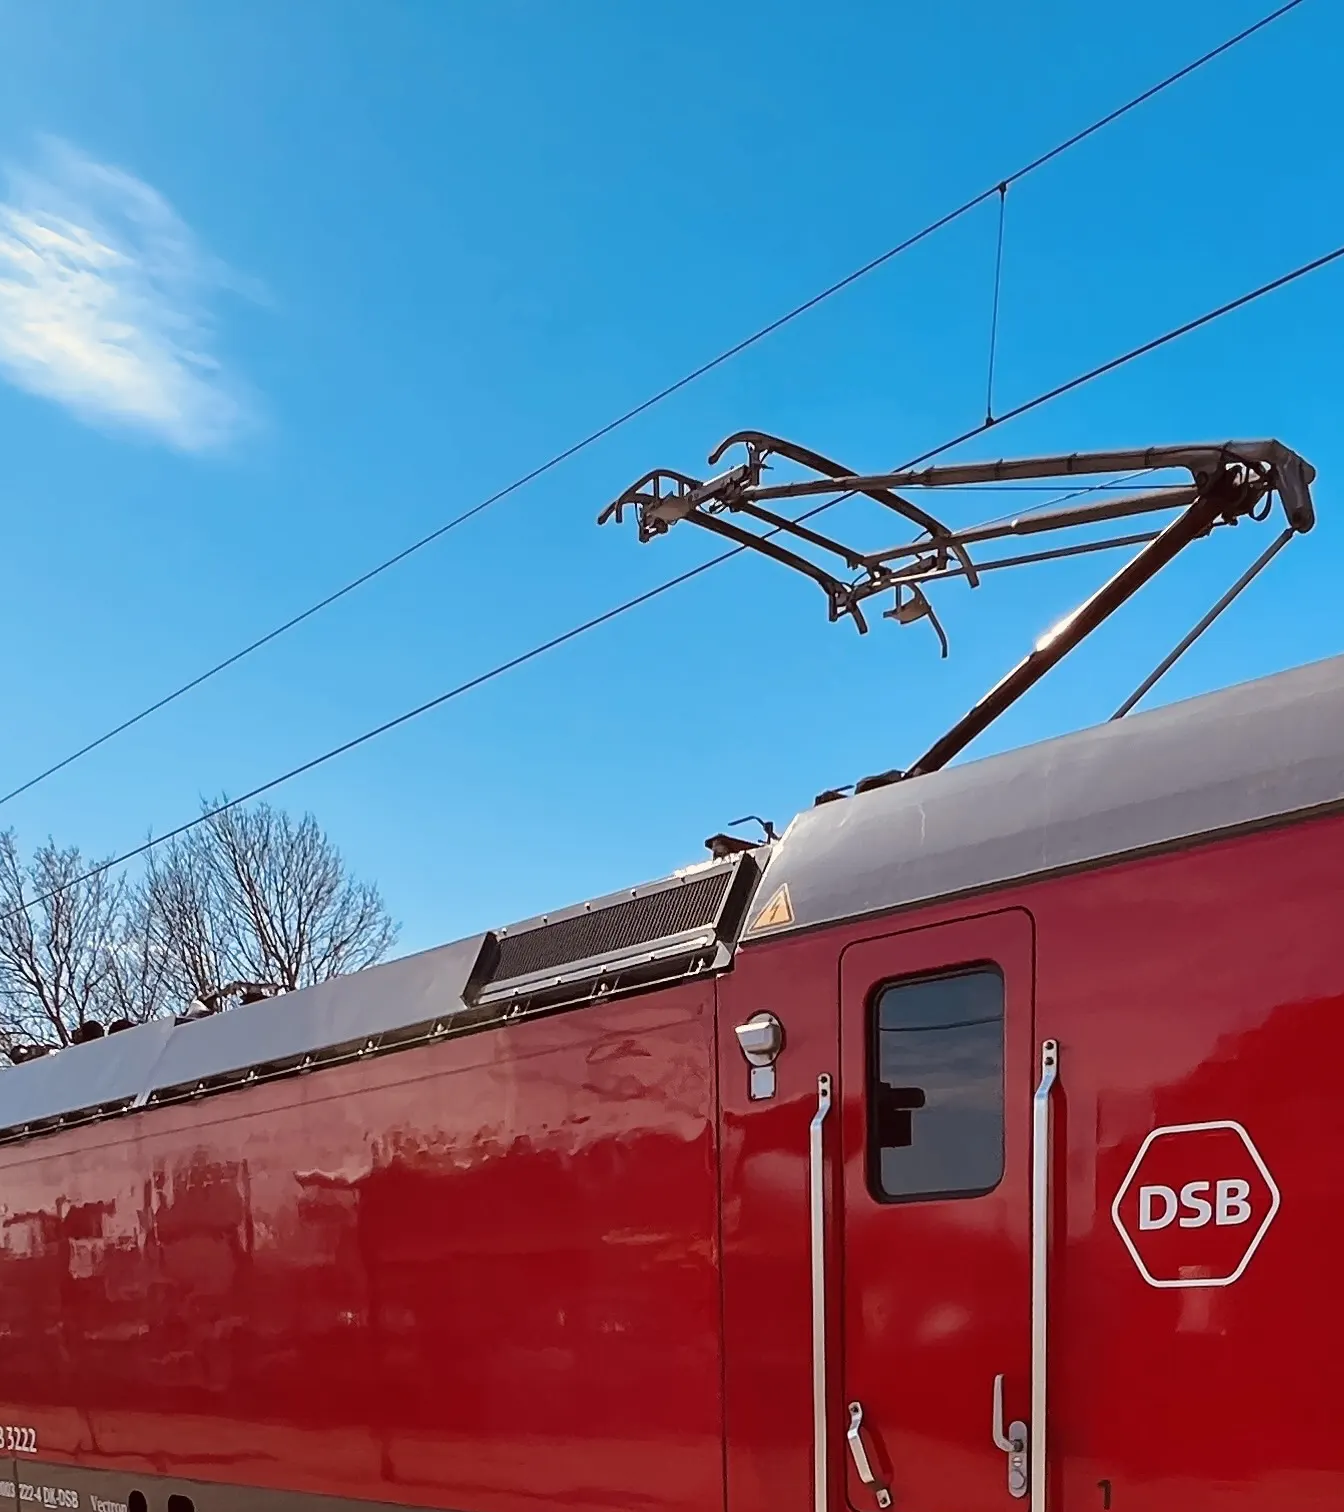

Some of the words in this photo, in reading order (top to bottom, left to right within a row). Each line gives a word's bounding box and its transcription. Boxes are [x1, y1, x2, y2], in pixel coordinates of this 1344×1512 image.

[1138, 1177, 1253, 1231] DSB
[6, 1426, 37, 1452] 3222
[44, 1486, 79, 1509] DK-DSB
[1096, 1478, 1114, 1511] 1
